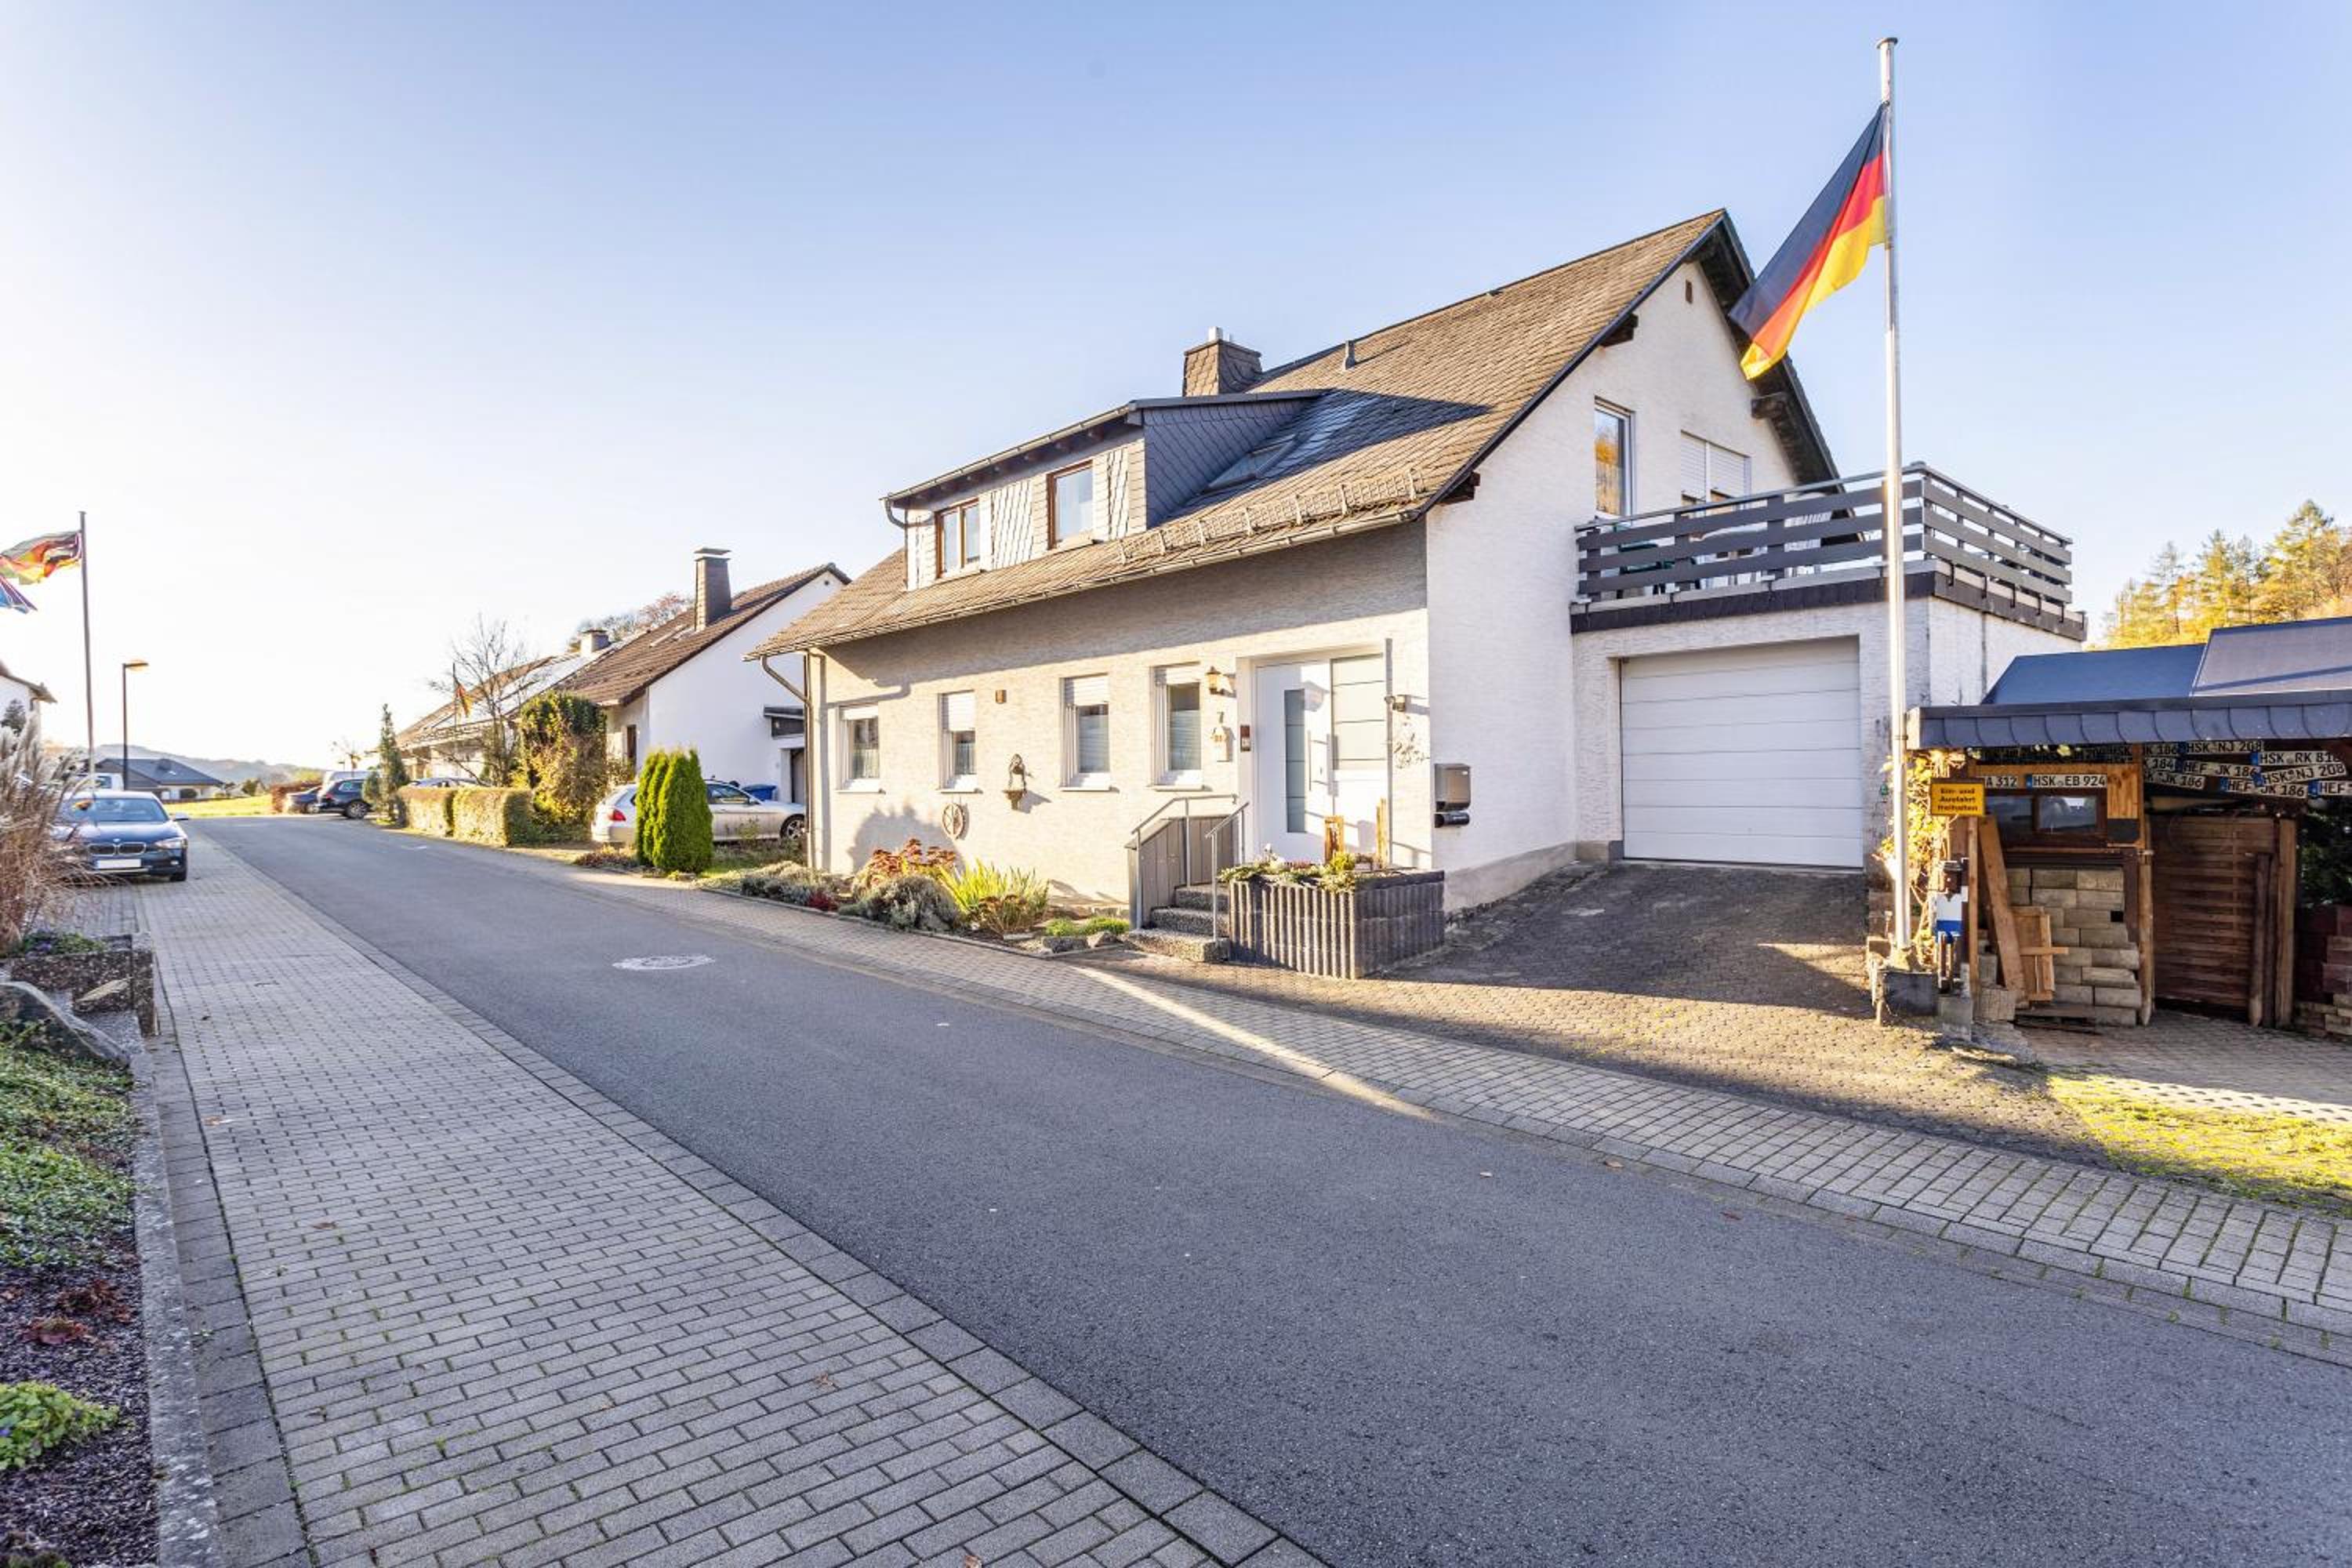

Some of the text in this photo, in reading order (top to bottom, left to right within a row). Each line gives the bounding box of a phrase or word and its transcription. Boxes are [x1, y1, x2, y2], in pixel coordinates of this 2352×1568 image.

[1217, 711, 1225, 724] 7
[2187, 742, 2209, 753] HSK
[2218, 742, 2234, 753] NJ
[2259, 752, 2284, 764] HSK
[2295, 753, 2311, 763] RK
[2183, 760, 2209, 773] HEF
[2215, 765, 2231, 775] JK
[2263, 763, 2345, 784] HSK NJ 208
[1996, 776, 2016, 787] 312
[2032, 776, 2106, 786] HSK EB 924
[2319, 781, 2346, 794] HEF
[2227, 779, 2304, 797] HEF JK 186
